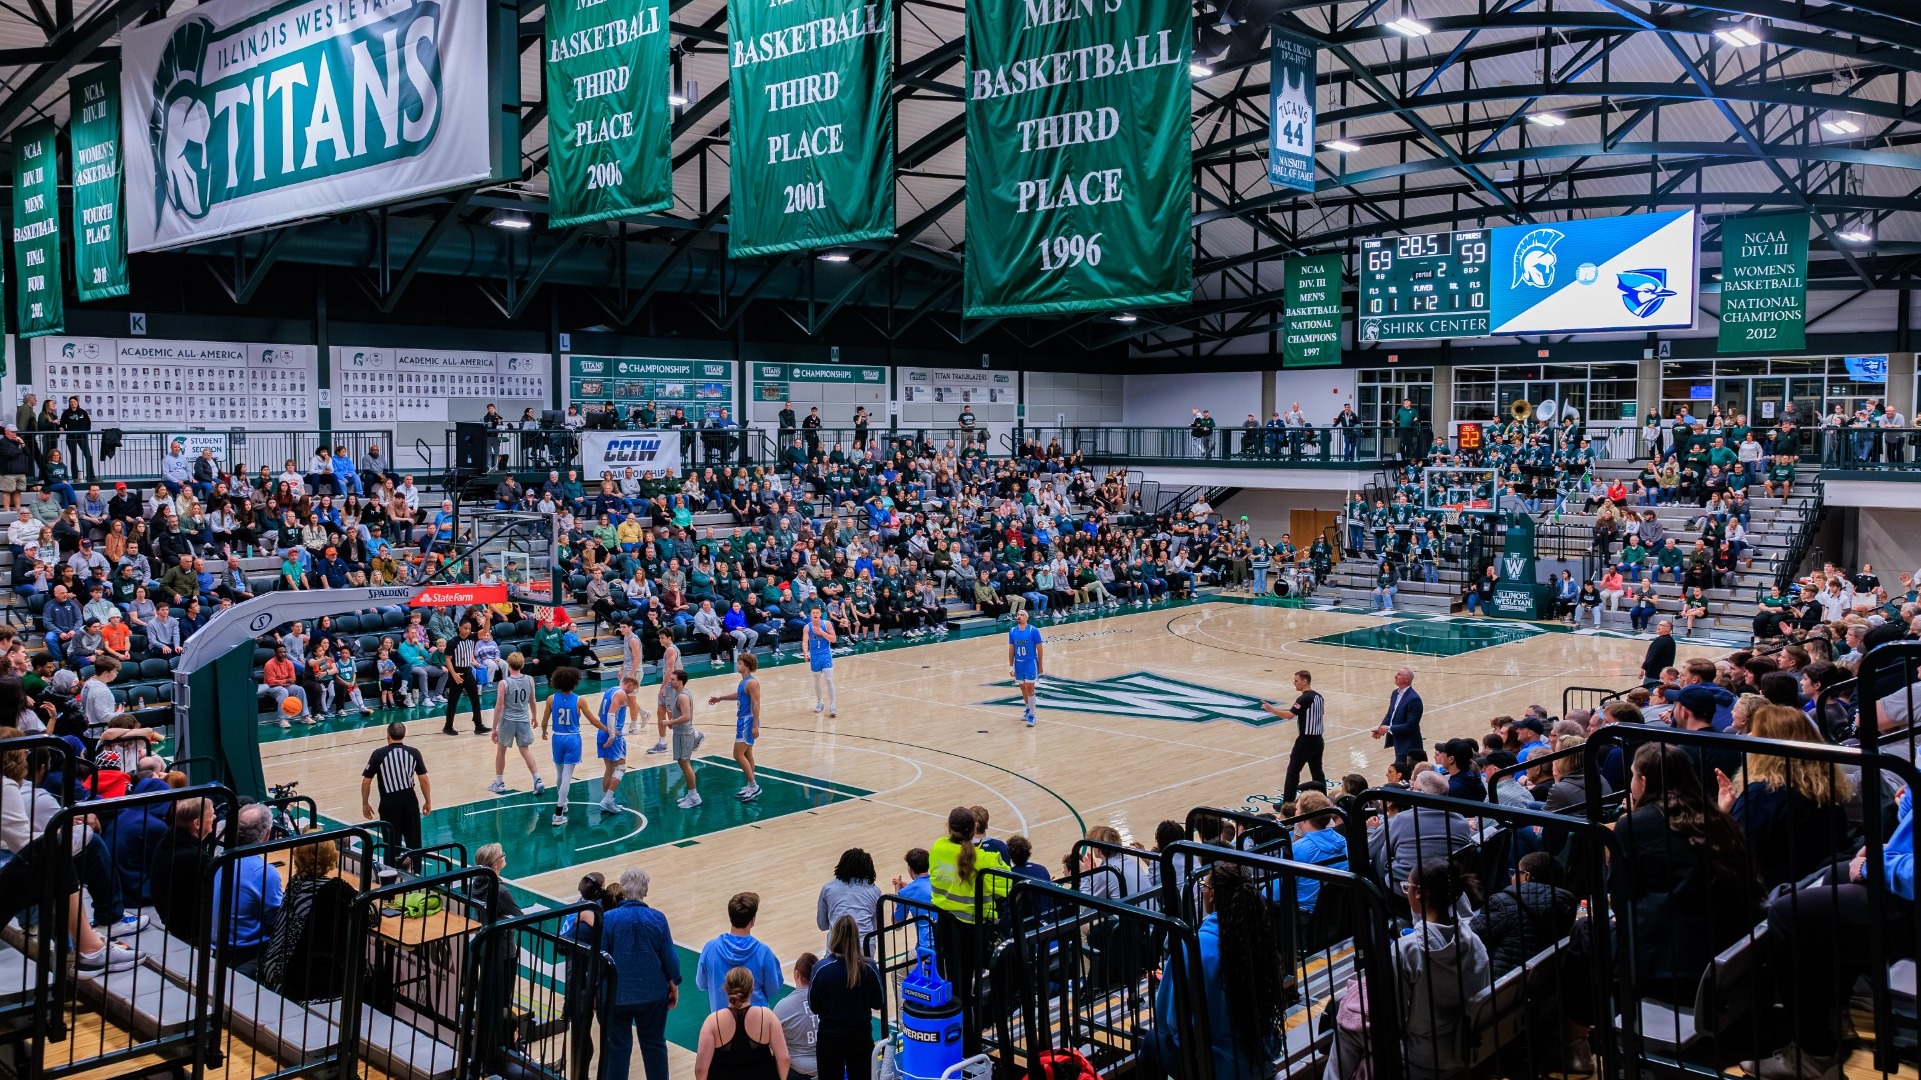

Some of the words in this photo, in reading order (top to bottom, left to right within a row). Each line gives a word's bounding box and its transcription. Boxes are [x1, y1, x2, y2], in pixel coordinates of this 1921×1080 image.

[549, 7, 661, 62] BASKETBALL
[732, 4, 886, 68] BASKETBALL
[218, 22, 286, 71] ILLINOIS
[971, 29, 1182, 101] BASKETBALL
[574, 66, 630, 101] THIRD
[84, 81, 105, 103] NCAA
[765, 71, 839, 112] THIRD
[214, 16, 438, 189] TITANS
[575, 112, 633, 146] PLACE
[1017, 107, 1120, 152] THIRD
[1283, 120, 1304, 147] 44
[24, 141, 42, 161] NCAA
[767, 124, 843, 164] PLACE
[587, 160, 622, 190] 2006
[783, 180, 826, 214] 2001
[1017, 169, 1123, 213] PLACE
[83, 203, 113, 225] FOURTH
[86, 225, 110, 244] PLACE
[1744, 231, 1786, 244] NCAA
[1039, 233, 1103, 271] 1996
[1400, 235, 1438, 257] 28.5
[1741, 245, 1771, 257] DIV.
[1773, 243, 1788, 255] III
[1461, 243, 1486, 264] 59
[1369, 251, 1391, 271] 69
[1301, 265, 1325, 274] NCAA
[1437, 262, 1447, 277] 2
[1734, 264, 1795, 277] WOMEN'S
[1299, 279, 1315, 288] DIV.
[1316, 279, 1326, 287] III
[1724, 278, 1802, 291] BASKETBALL
[1300, 292, 1325, 302] MEN'S
[1471, 292, 1484, 308] 10
[1727, 297, 1798, 309] NATIONAL
[1286, 305, 1339, 316] BASKETBALL
[1371, 299, 1382, 313] 10
[132, 316, 144, 330] K
[1723, 310, 1801, 322] CHAMPIONS
[1291, 320, 1332, 330] NATIONAL
[1383, 321, 1425, 335] SHIRK
[1430, 318, 1487, 332] CENTER
[1288, 333, 1337, 343] CHAMPIONS
[1746, 328, 1777, 339] 2012
[561, 336, 568, 348] L
[121, 348, 173, 357] ACADEMIC
[177, 349, 243, 360] ALL-AMERICA
[1304, 348, 1320, 357] 1997
[1660, 343, 1670, 356] A
[399, 356, 439, 365] ACADEMIC
[442, 358, 494, 367] ALL-AMERICA
[629, 364, 690, 374] CHAMPIONSHIPS
[801, 369, 852, 378] CHAMPIONSHIPS
[934, 372, 950, 380] TITAN
[952, 373, 988, 381] TRAILBLAZERS
[1461, 431, 1480, 447] 22
[603, 440, 662, 462] CCIW
[368, 588, 409, 598] SPALDING
[432, 593, 453, 603] State
[453, 592, 473, 602] Farm
[1498, 592, 1528, 600] ILLINOIS
[1494, 597, 1532, 607] WESLEYAN
[1016, 646, 1027, 657] 40
[514, 688, 527, 704] 10
[558, 708, 571, 726] 21
[904, 988, 931, 1001] POWERADE
